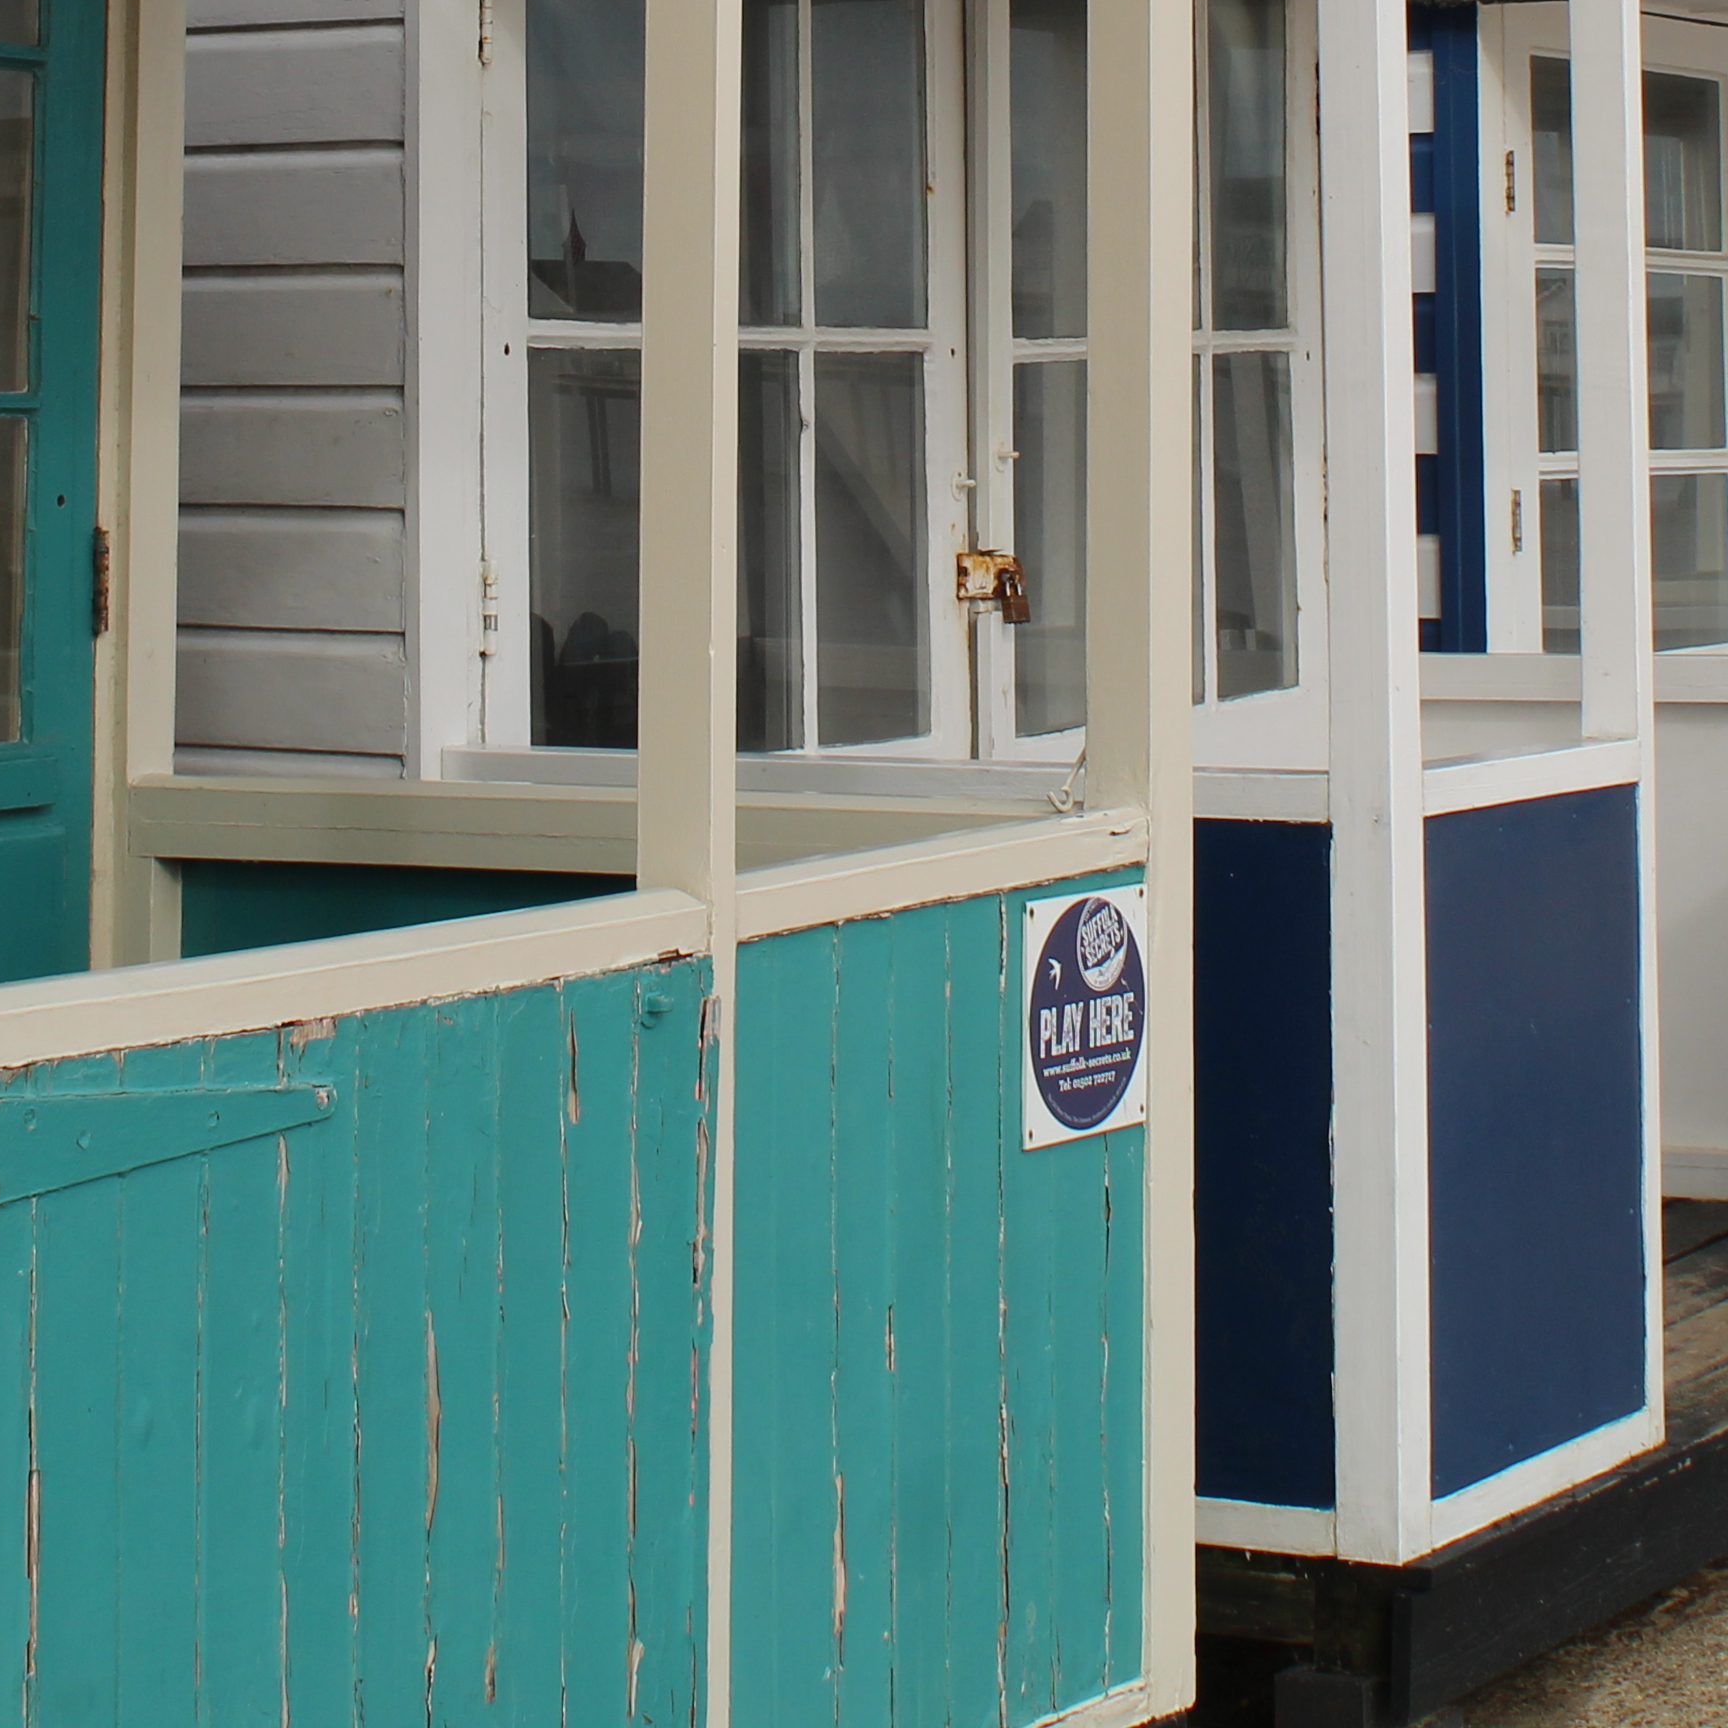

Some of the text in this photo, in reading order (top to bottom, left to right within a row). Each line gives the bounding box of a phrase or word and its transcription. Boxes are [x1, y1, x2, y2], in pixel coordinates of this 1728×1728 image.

[1081, 903, 1118, 947] SUFFOLK
[1085, 922, 1122, 968] SECRETS
[1040, 992, 1134, 1059] PLAY HERE
[1043, 1047, 1132, 1077] www.suffolk-secrets.co.uk
